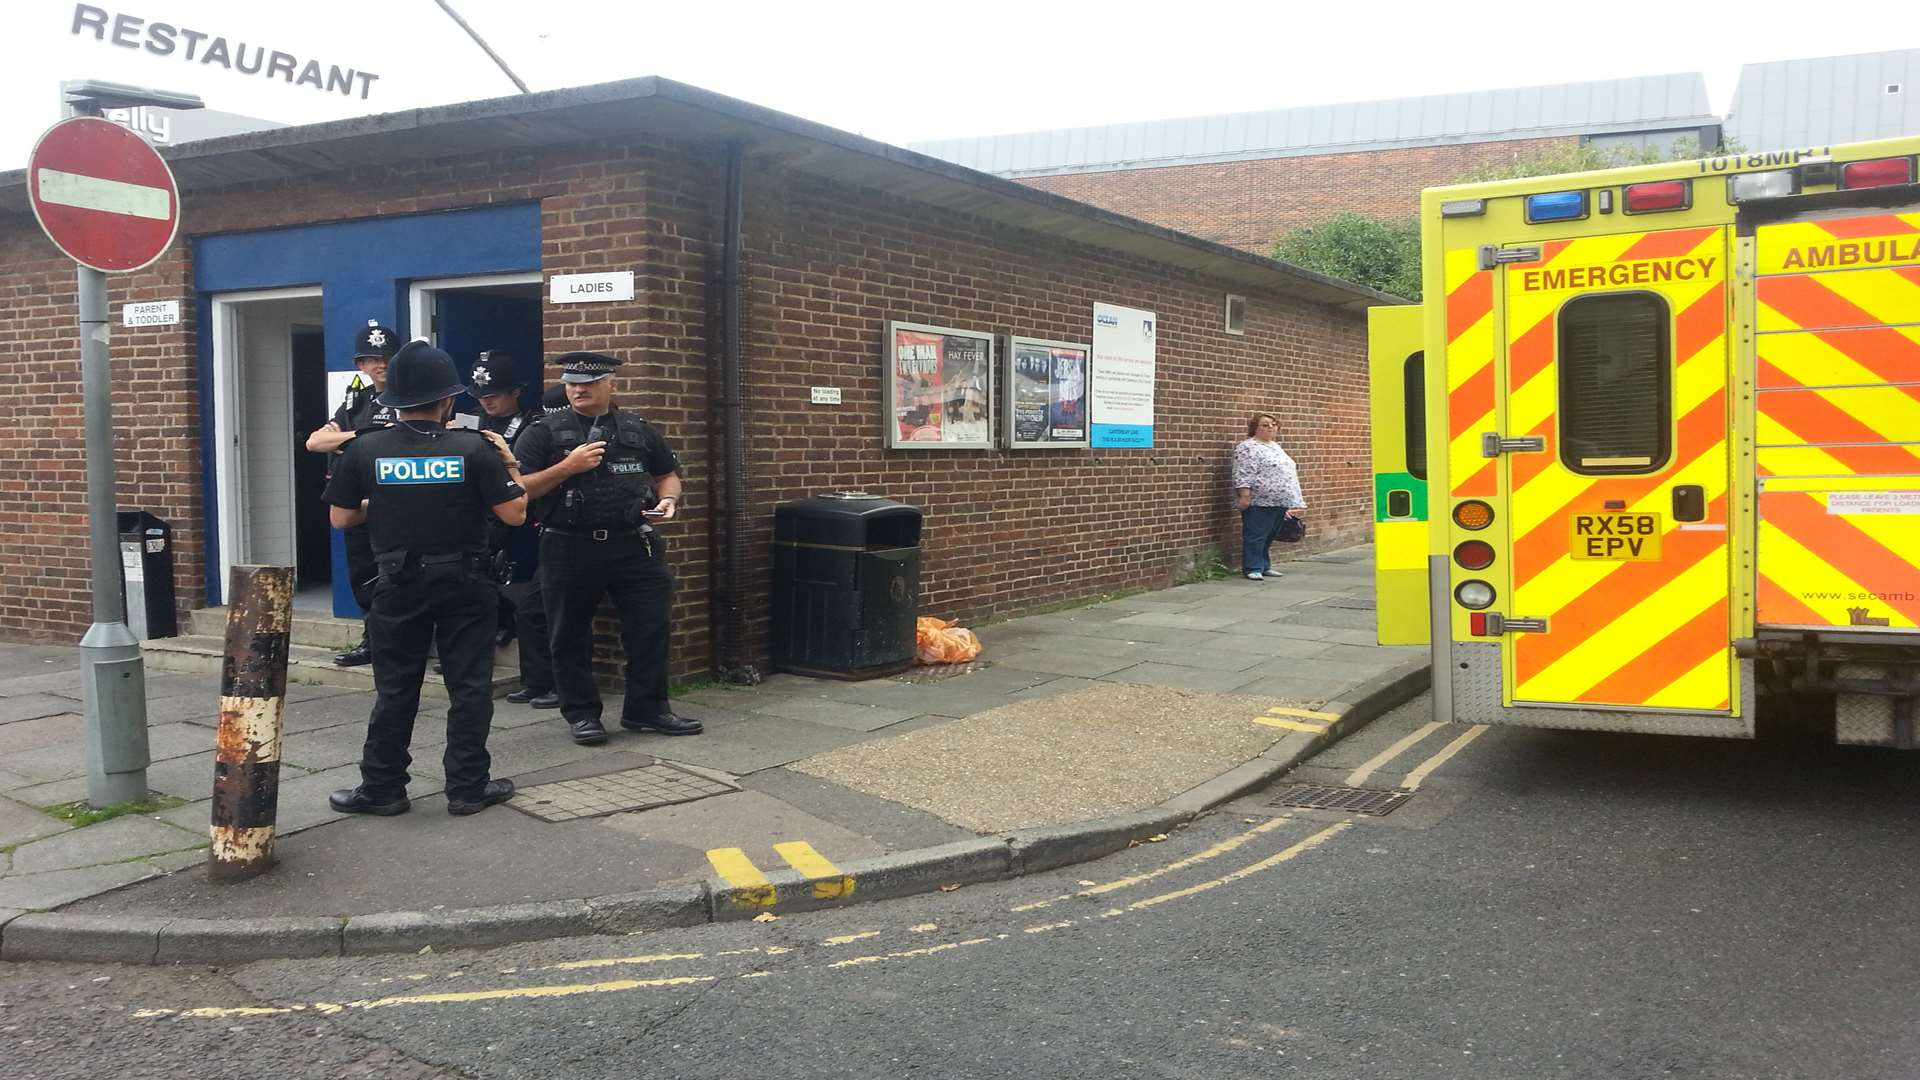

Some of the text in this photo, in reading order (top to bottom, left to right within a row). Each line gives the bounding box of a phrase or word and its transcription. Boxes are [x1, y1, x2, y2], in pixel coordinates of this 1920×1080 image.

[71, 3, 379, 100] RESTAURANT
[106, 105, 170, 143] elly
[1524, 257, 1716, 291] EMERGENCY
[570, 282, 614, 294] LADIES
[134, 304, 167, 314] PARENT
[128, 314, 174, 325] & TODDLER
[948, 351, 985, 361] HAY FEVER
[380, 461, 460, 480] POLICE
[612, 463, 642, 473] POLICE
[1577, 516, 1654, 535] RX58
[1587, 538, 1644, 556] EPV
